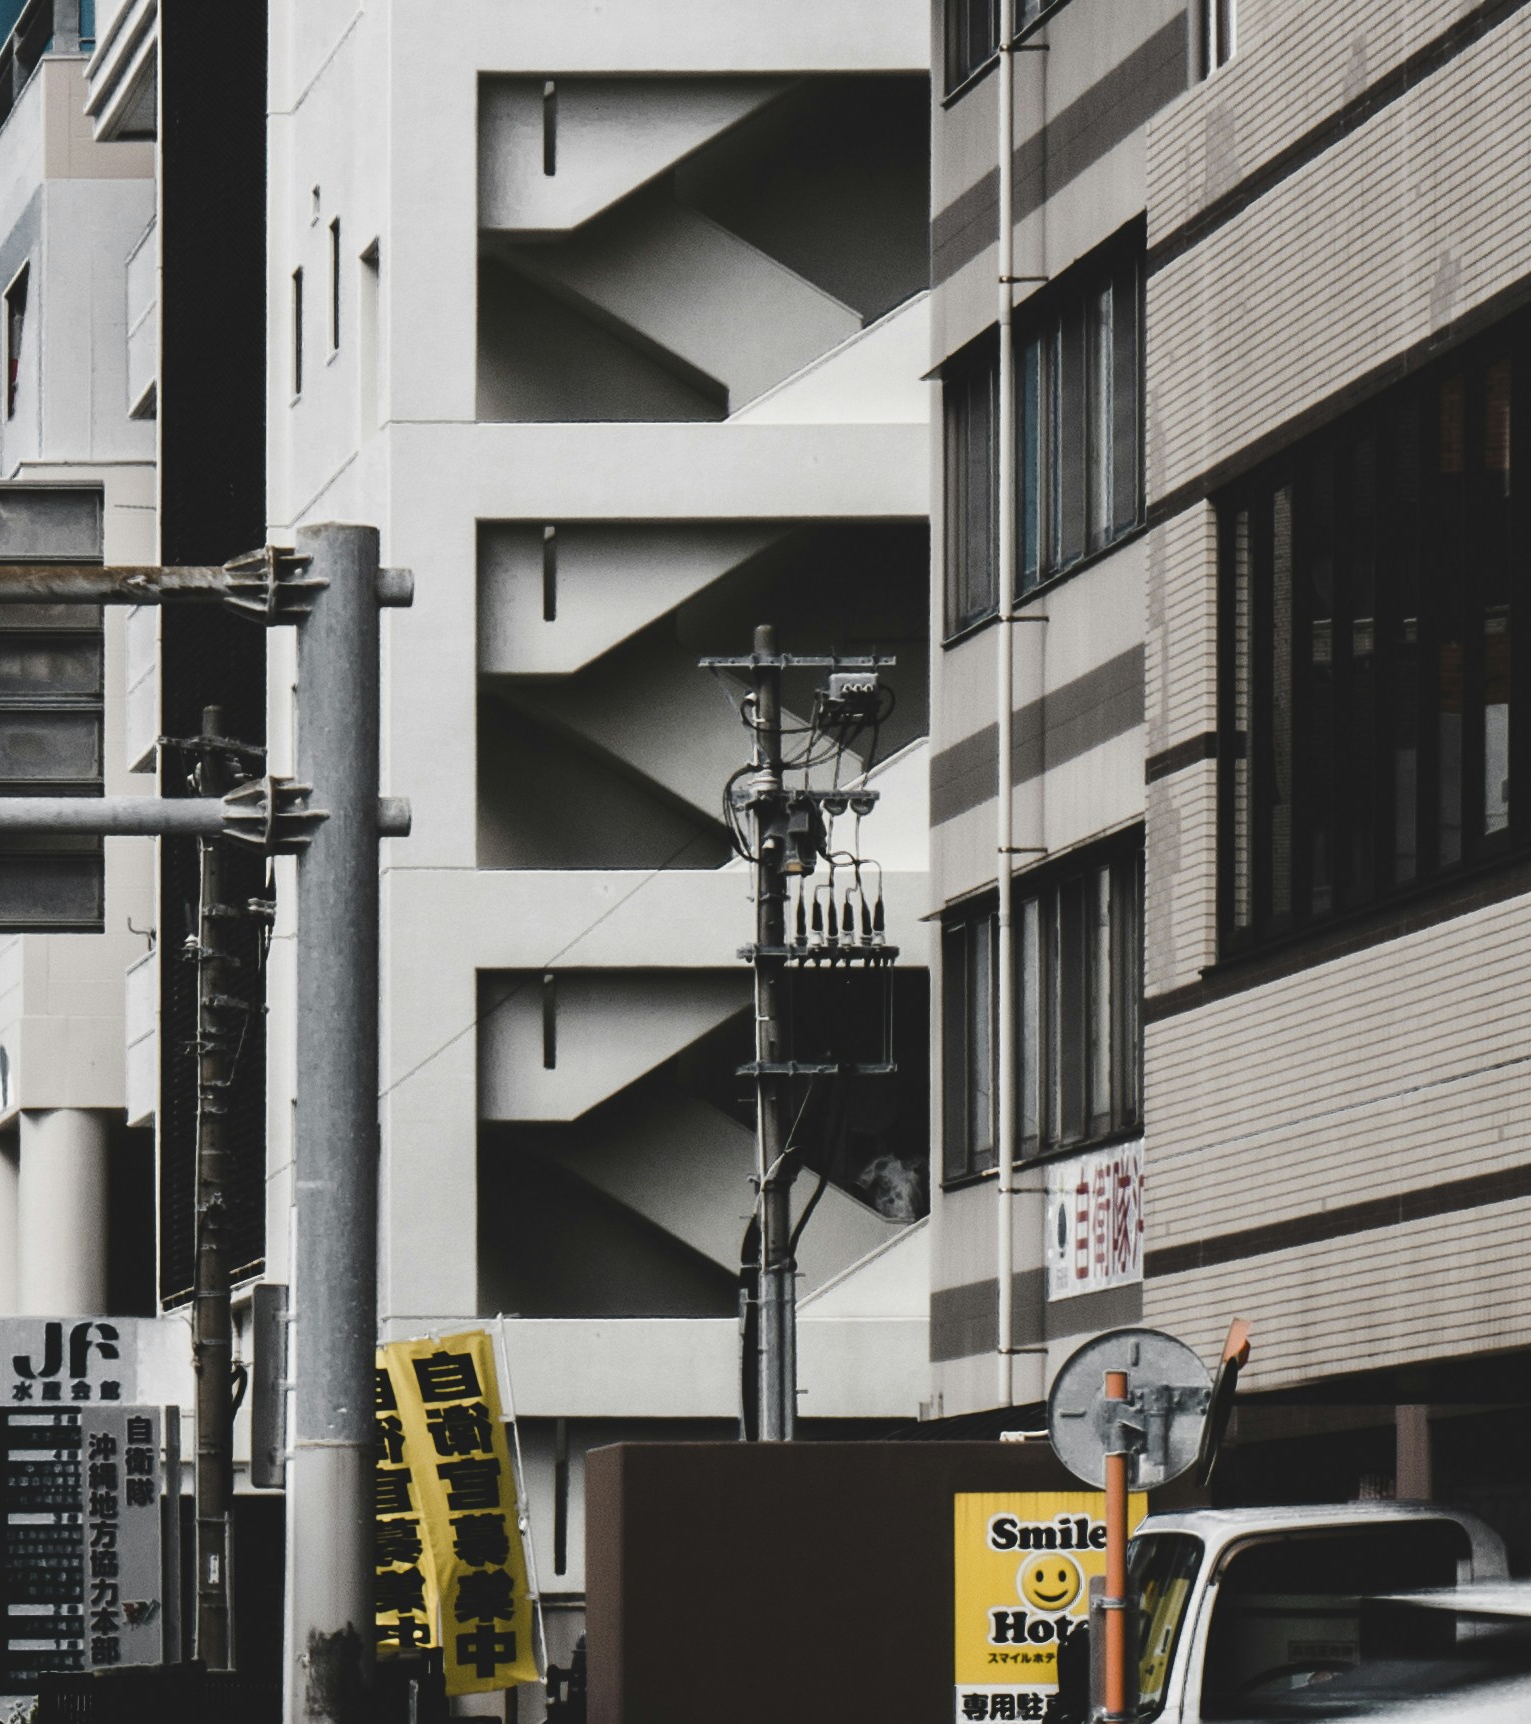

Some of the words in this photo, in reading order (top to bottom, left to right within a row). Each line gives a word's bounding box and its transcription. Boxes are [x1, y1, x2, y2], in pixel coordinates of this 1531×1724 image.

[12, 1321, 120, 1379] JF
[125, 1416, 154, 1508] 自衛隊
[89, 1433, 120, 1666] 沖縄地方協力本部
[412, 1351, 517, 1679] 自衛官募集中
[992, 1517, 1107, 1550] Smile
[988, 1652, 1056, 1664] スマイルホテ
